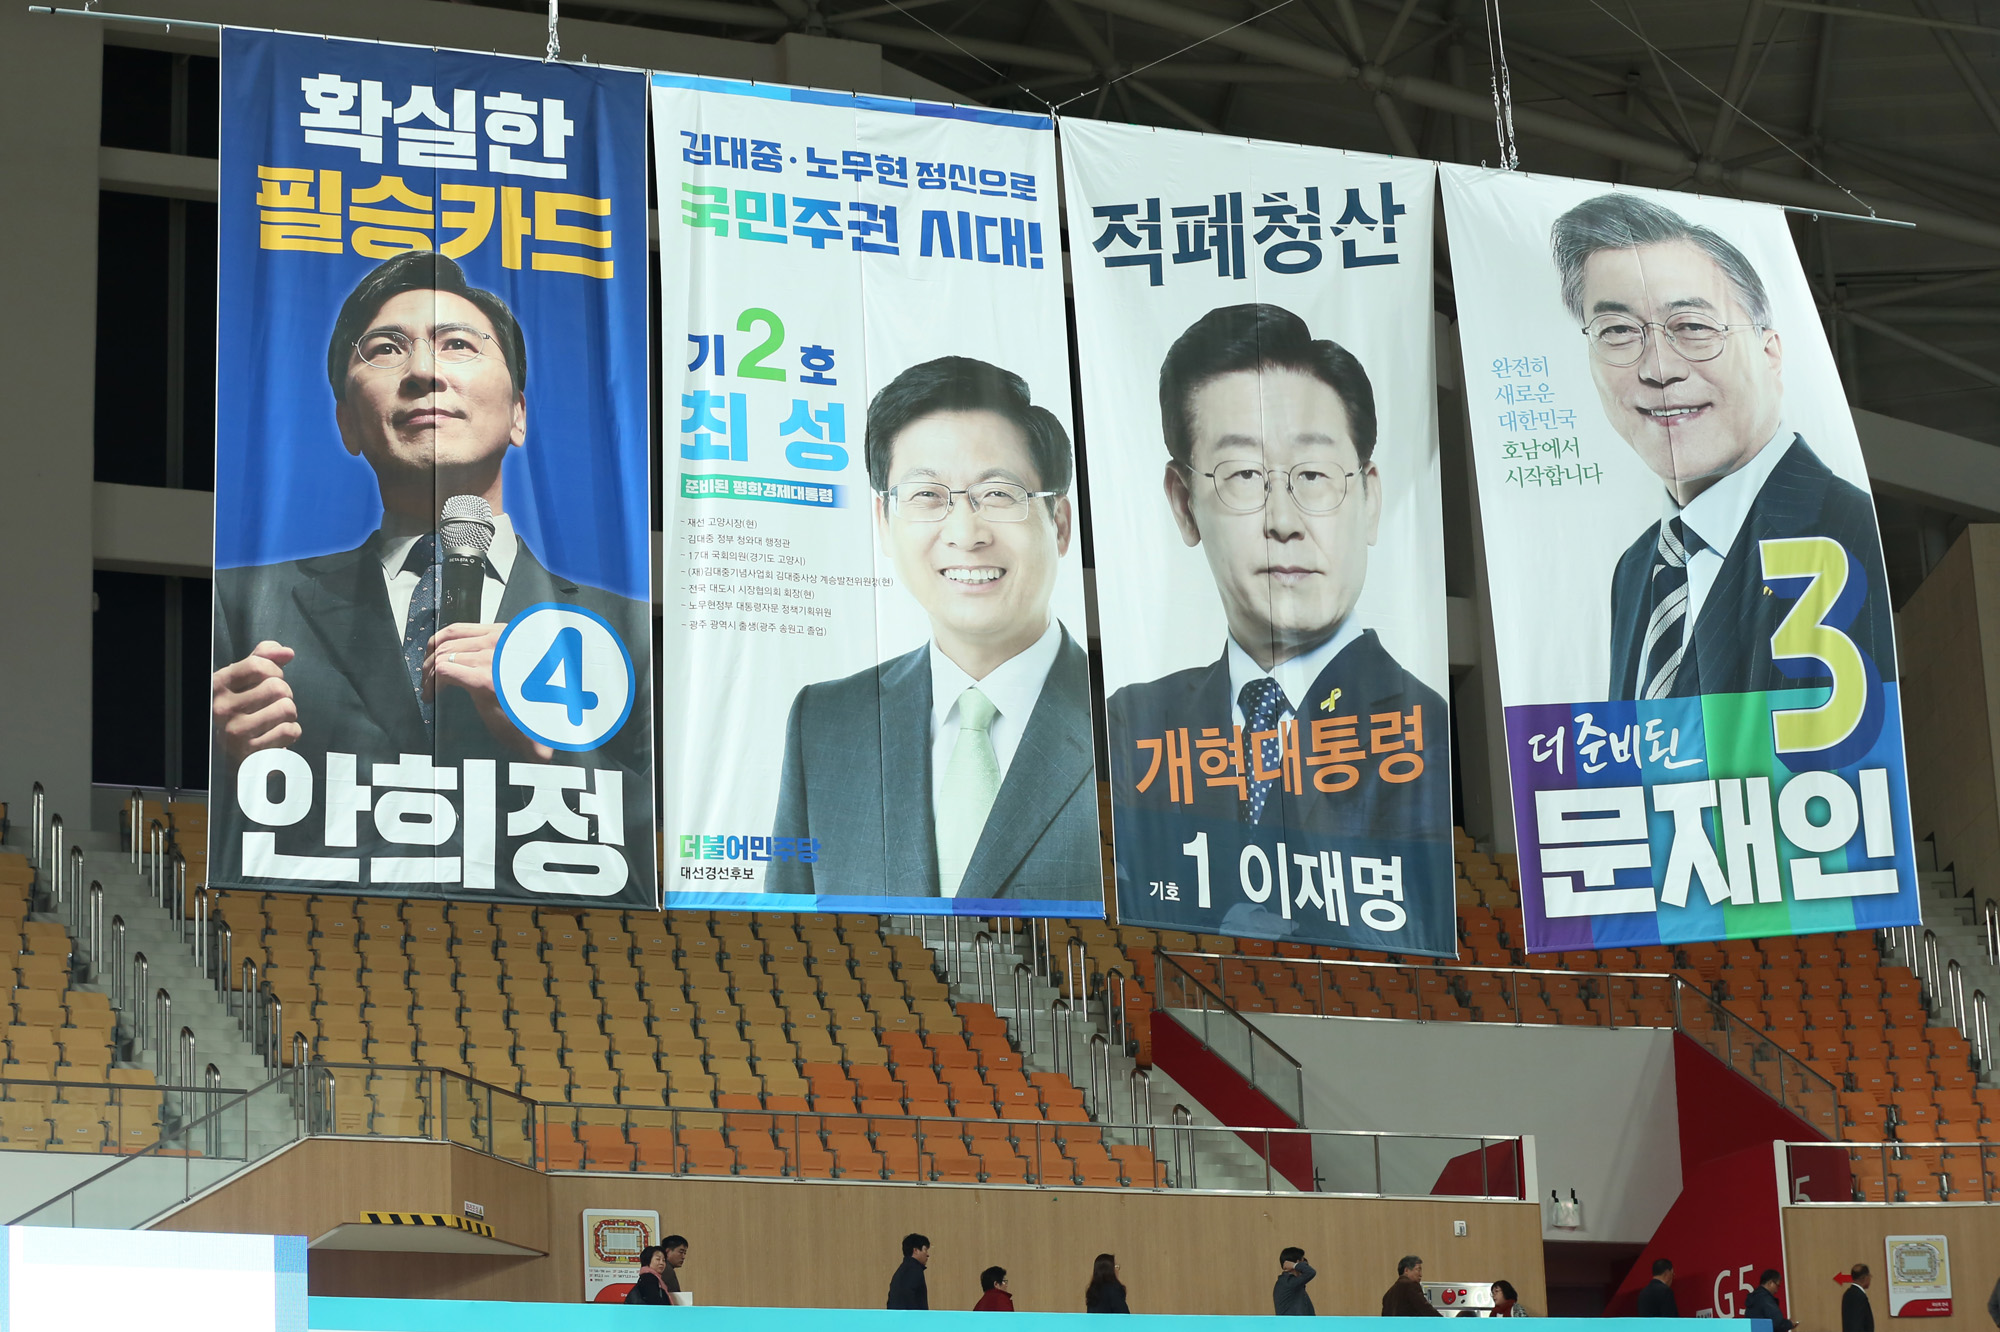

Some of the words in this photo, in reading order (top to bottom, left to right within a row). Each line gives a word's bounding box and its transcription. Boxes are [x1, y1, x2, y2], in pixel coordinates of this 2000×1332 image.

[300, 73, 574, 180] 확실한
[915, 161, 1038, 202] 정신으로
[256, 164, 614, 280] 필승카드
[681, 182, 900, 256] 국민주권
[919, 209, 1044, 270] 시대!
[1092, 181, 1407, 287] 적폐청산
[1490, 355, 1549, 379] 완전히
[1494, 382, 1555, 406] 새로운
[1497, 408, 1577, 433] 대한민국
[1501, 436, 1580, 461] 호남에서
[1505, 462, 1604, 489] 시작합니다
[685, 478, 729, 494] 준비된
[732, 480, 834, 504] 평화경제대통령
[687, 517, 705, 528] 재선
[707, 517, 758, 530] 고양시장(현)
[687, 533, 714, 545] 김대중
[717, 533, 735, 544] 정부
[736, 534, 763, 546] 청와대
[765, 537, 790, 549] 행정관
[688, 550, 709, 560] 17대
[711, 550, 775, 563] 국회의원(경기도
[777, 554, 806, 566] 고양시)
[688, 583, 706, 594] 전국
[709, 583, 736, 594] 대도시
[738, 585, 781, 597] 시장협의회
[783, 587, 815, 600] 회장(현)
[776, 570, 818, 584] 김대중사상
[820, 574, 894, 588] 계승발전위원장(현)
[688, 599, 733, 611] 노무현정부
[736, 601, 780, 614] 대통령자문
[781, 604, 832, 618] 정책기획위원
[688, 619, 707, 631] 광주
[709, 619, 737, 631] 광역시
[778, 623, 805, 635] 송원고
[806, 625, 828, 637] 졸업)
[1758, 536, 1869, 755] 3
[520, 626, 599, 727] 4
[1135, 704, 1425, 805] 개혁대통령
[1528, 726, 1565, 775] 더
[1574, 711, 1705, 775] 준비된
[237, 747, 629, 896] 안희정
[679, 834, 822, 863] 더불어민주당
[1533, 767, 1900, 919] 문재인
[680, 866, 755, 880] 대선경선후보
[1149, 880, 1181, 903] 기호
[1182, 831, 1212, 909] 1
[1239, 842, 1408, 932] 이재명
[1713, 1263, 1755, 1319] G5
